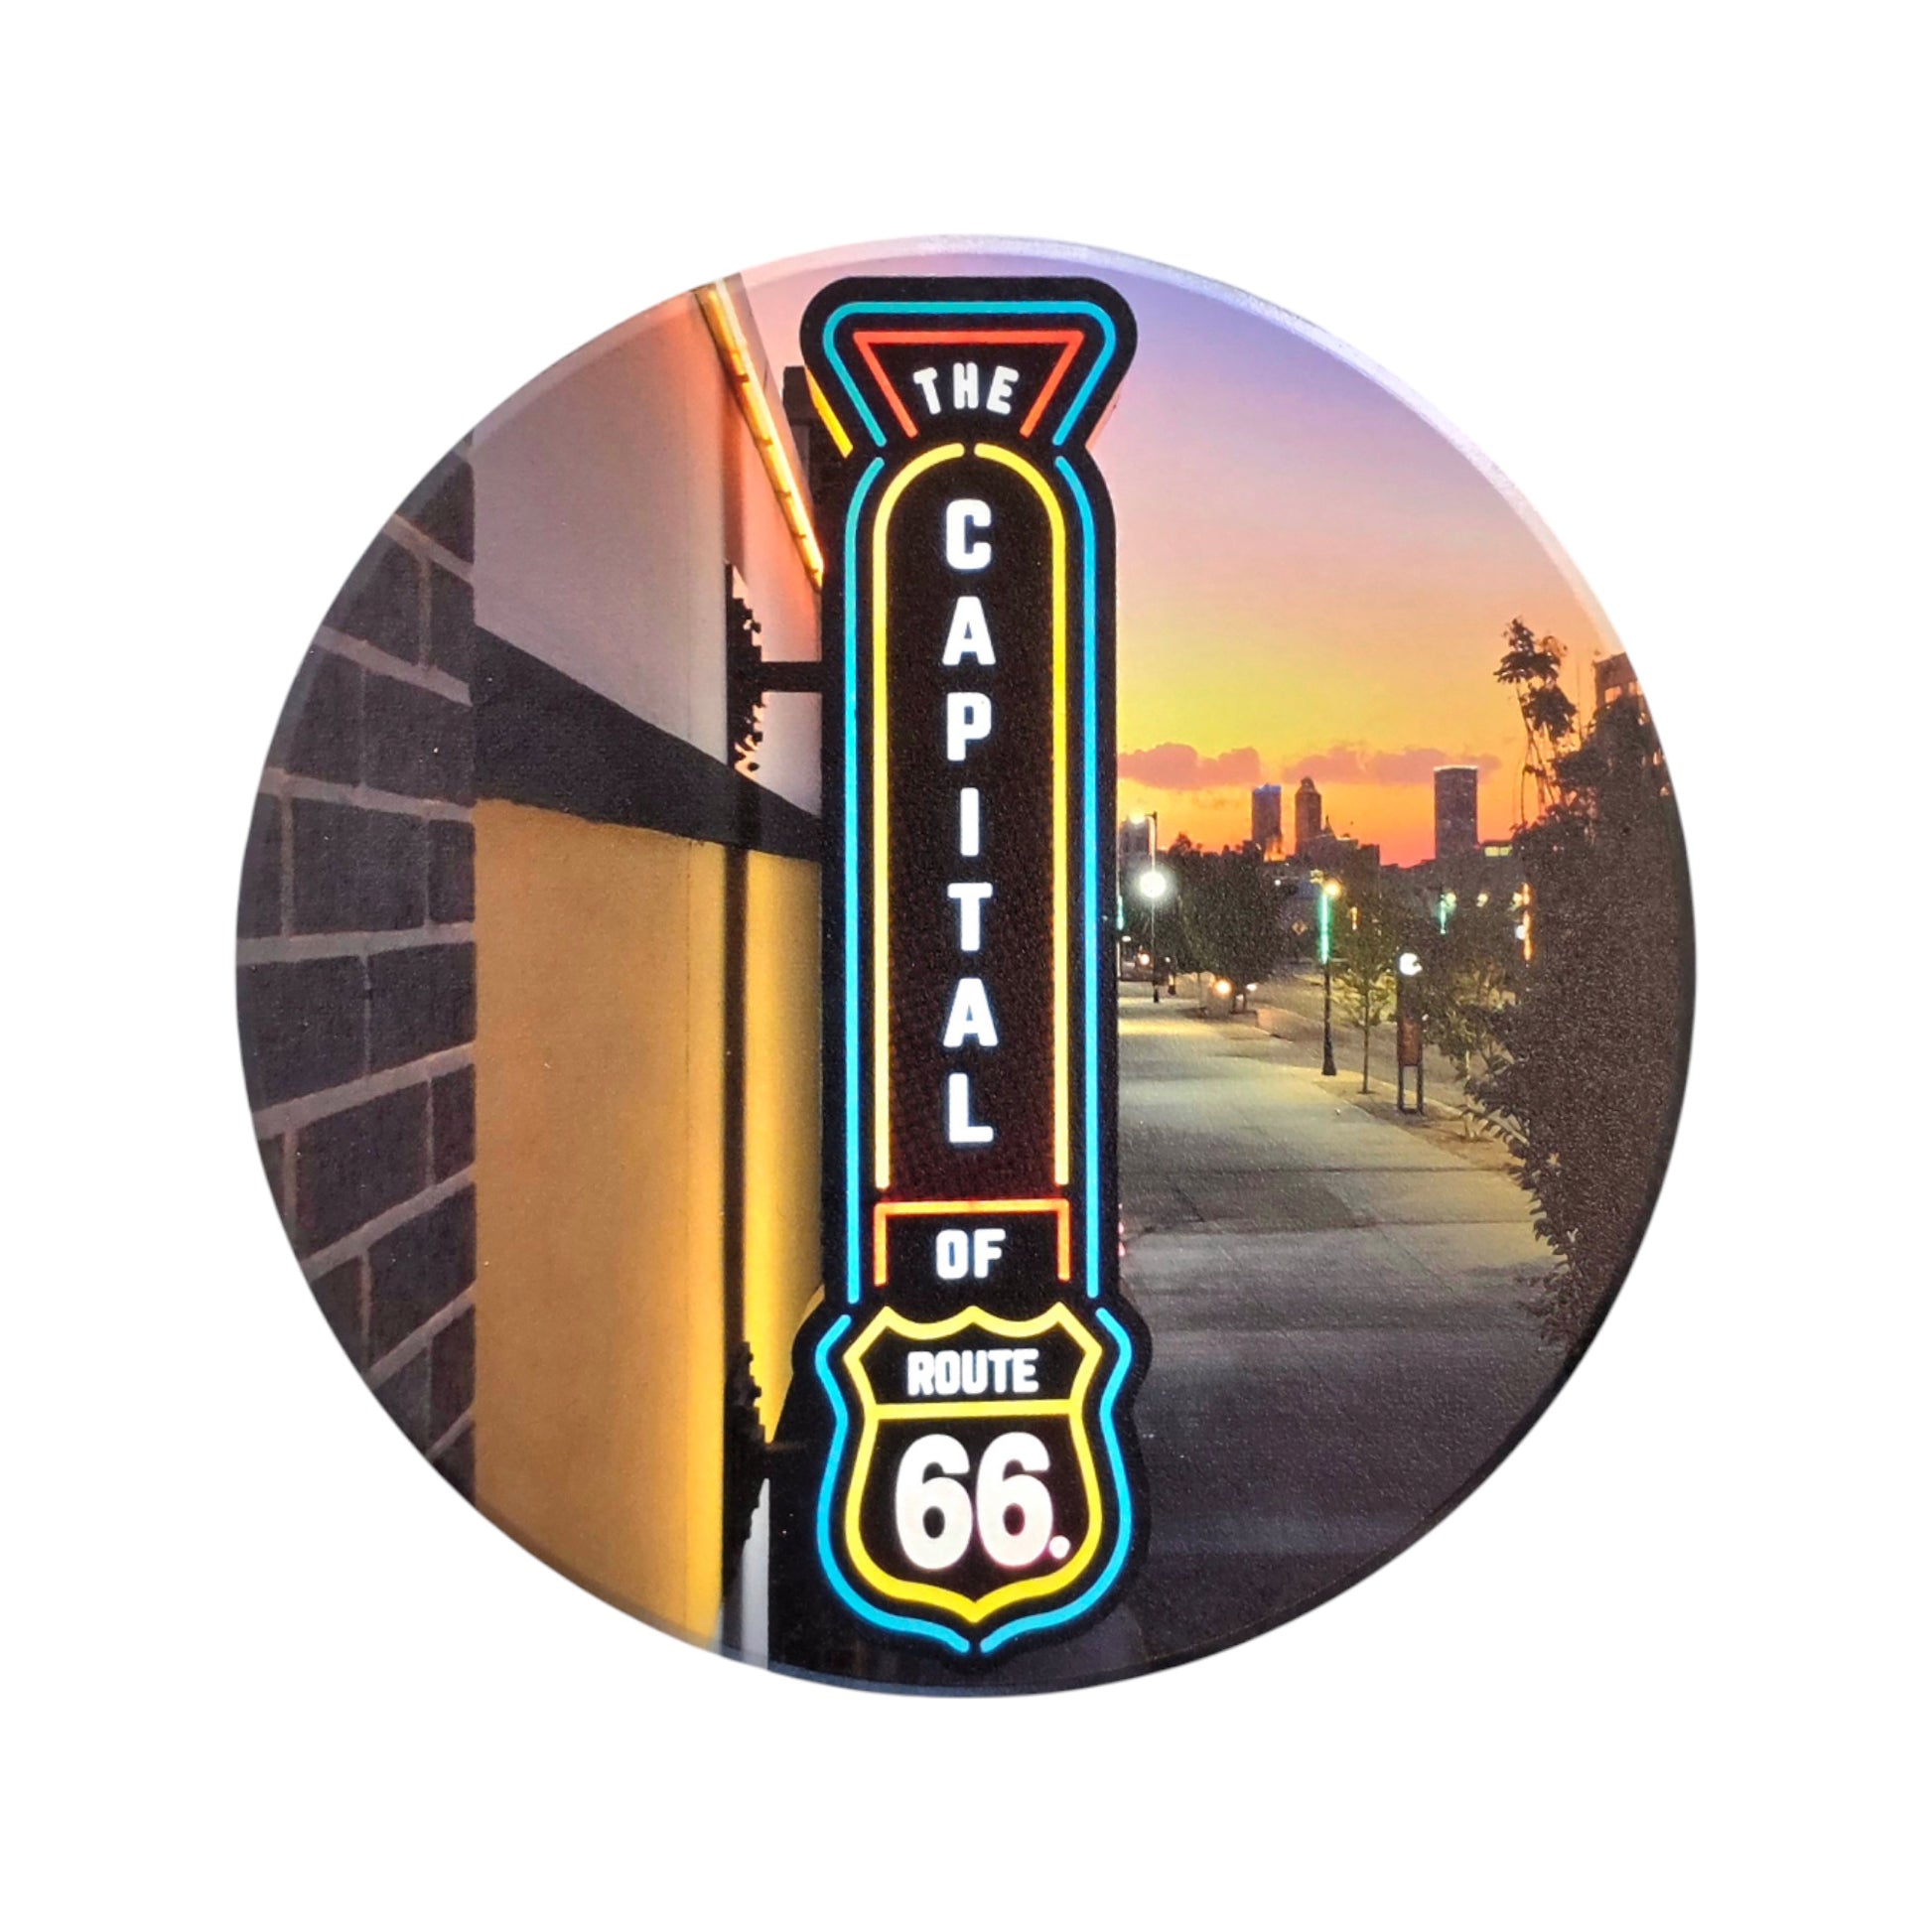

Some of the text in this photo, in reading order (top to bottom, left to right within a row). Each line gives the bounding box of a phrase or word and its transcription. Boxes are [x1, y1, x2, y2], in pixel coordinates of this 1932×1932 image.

[912, 361, 1021, 416] THE
[940, 497, 999, 1145] CAPITAL
[935, 1228, 1007, 1281] OF
[906, 1347, 1040, 1397] ROUTE
